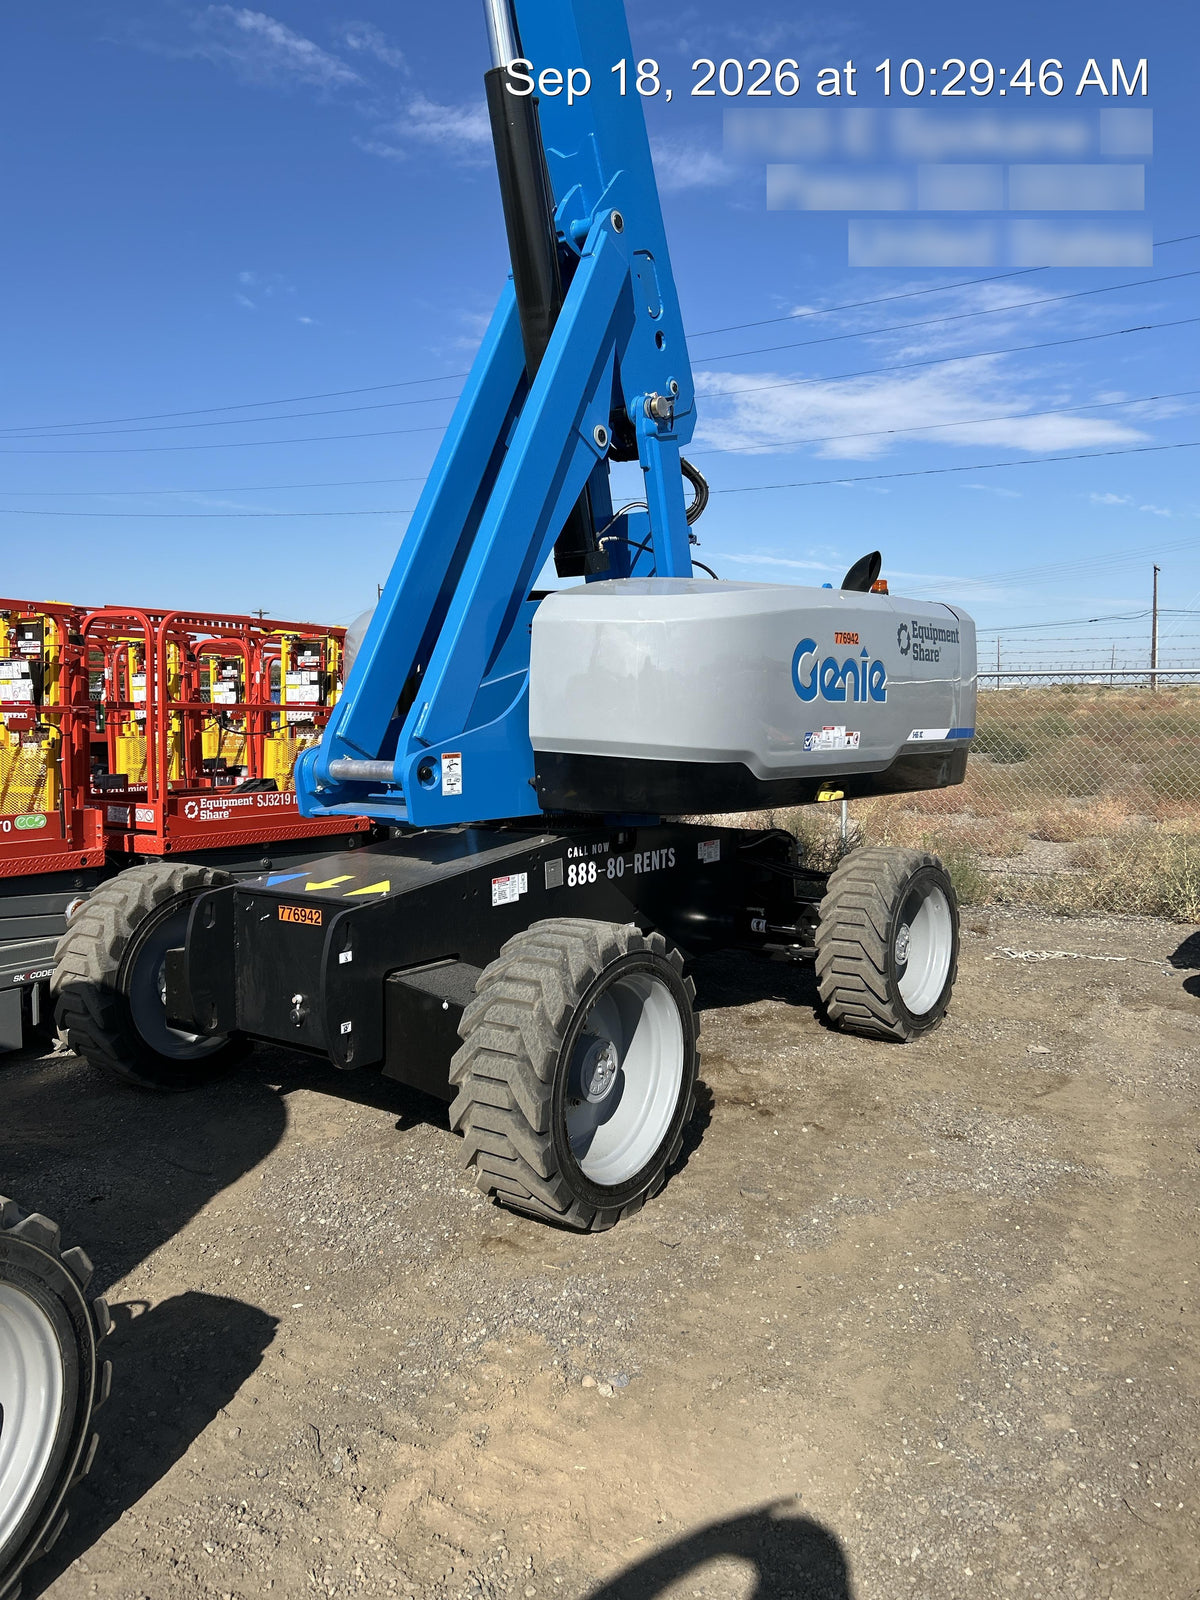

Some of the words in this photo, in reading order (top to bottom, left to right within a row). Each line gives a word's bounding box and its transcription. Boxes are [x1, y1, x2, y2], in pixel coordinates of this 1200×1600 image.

[835, 631, 859, 645] 776942
[911, 620, 960, 645] Equipment
[912, 643, 941, 663] Share
[791, 637, 888, 703] Genie
[200, 796, 253, 809] Equipment
[257, 792, 291, 807] SJ3219
[200, 809, 230, 820] Share
[567, 846, 589, 859] CALL
[592, 842, 610, 854] NOW
[567, 847, 676, 887] 888-80-RENTS
[279, 906, 321, 925] 776942
